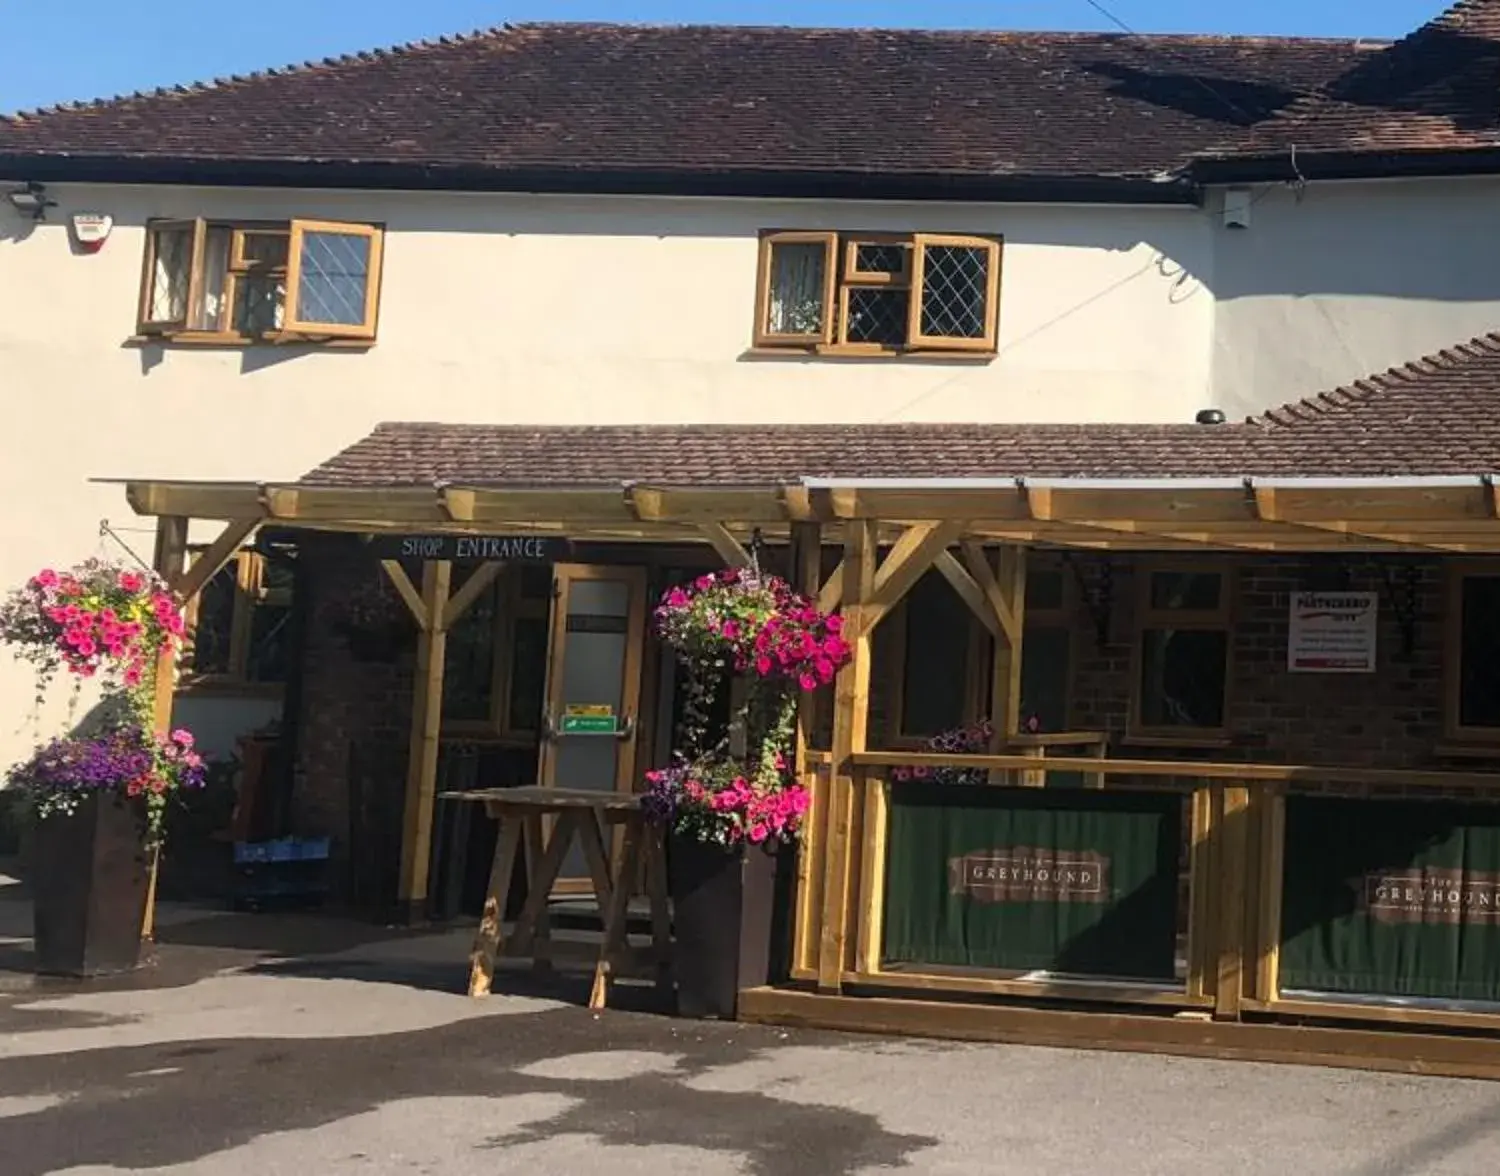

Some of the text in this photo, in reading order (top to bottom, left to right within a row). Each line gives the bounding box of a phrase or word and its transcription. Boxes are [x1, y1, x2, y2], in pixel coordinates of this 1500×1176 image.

[402, 537, 545, 557] SHOP ENTRANCE
[973, 866, 1092, 884] GREYHOUND
